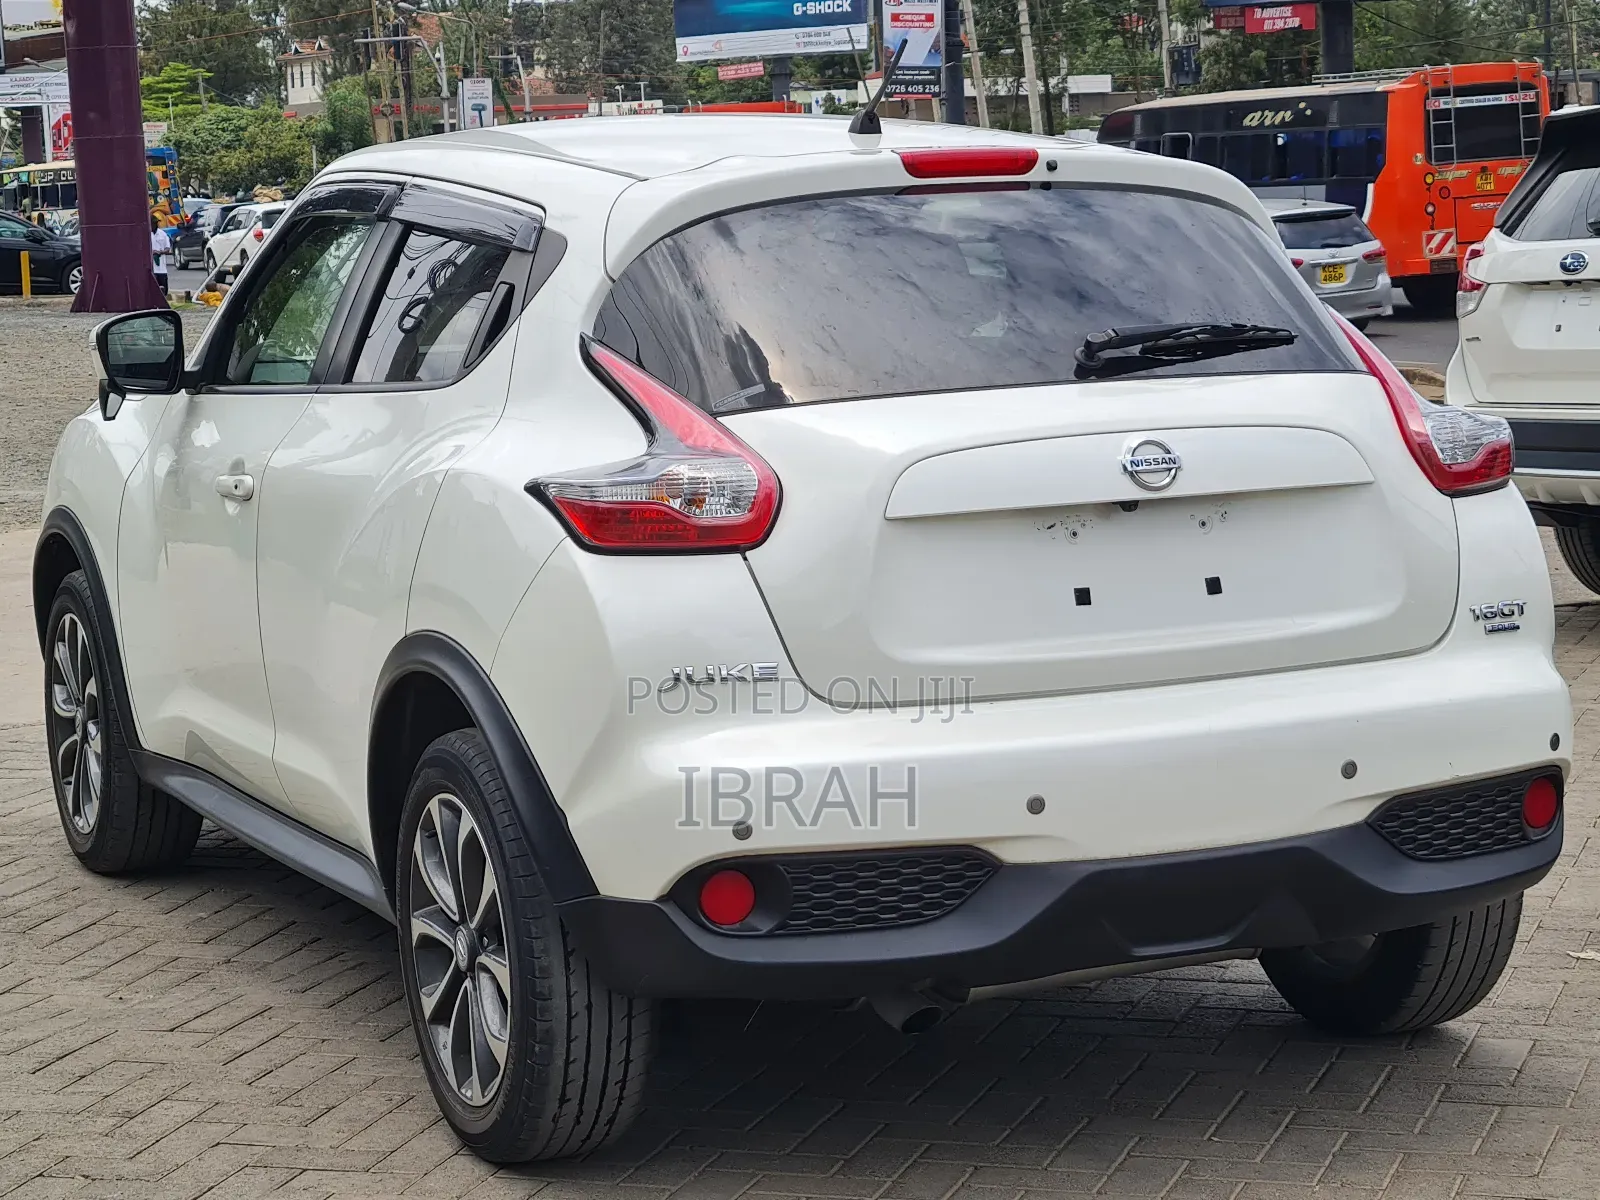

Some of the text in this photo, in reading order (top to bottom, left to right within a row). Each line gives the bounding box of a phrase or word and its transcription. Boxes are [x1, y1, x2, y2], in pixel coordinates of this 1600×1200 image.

[793, 0, 852, 15] G-SHOCK
[1253, 6, 1293, 18] TO ADVERTISE
[1504, 93, 1536, 102] ISUZU
[1321, 264, 1338, 273] KCE
[1322, 273, 1344, 282] 486P
[1130, 456, 1177, 468] NISSAN
[1469, 599, 1528, 622] 16GT
[657, 661, 780, 694] JUKE
